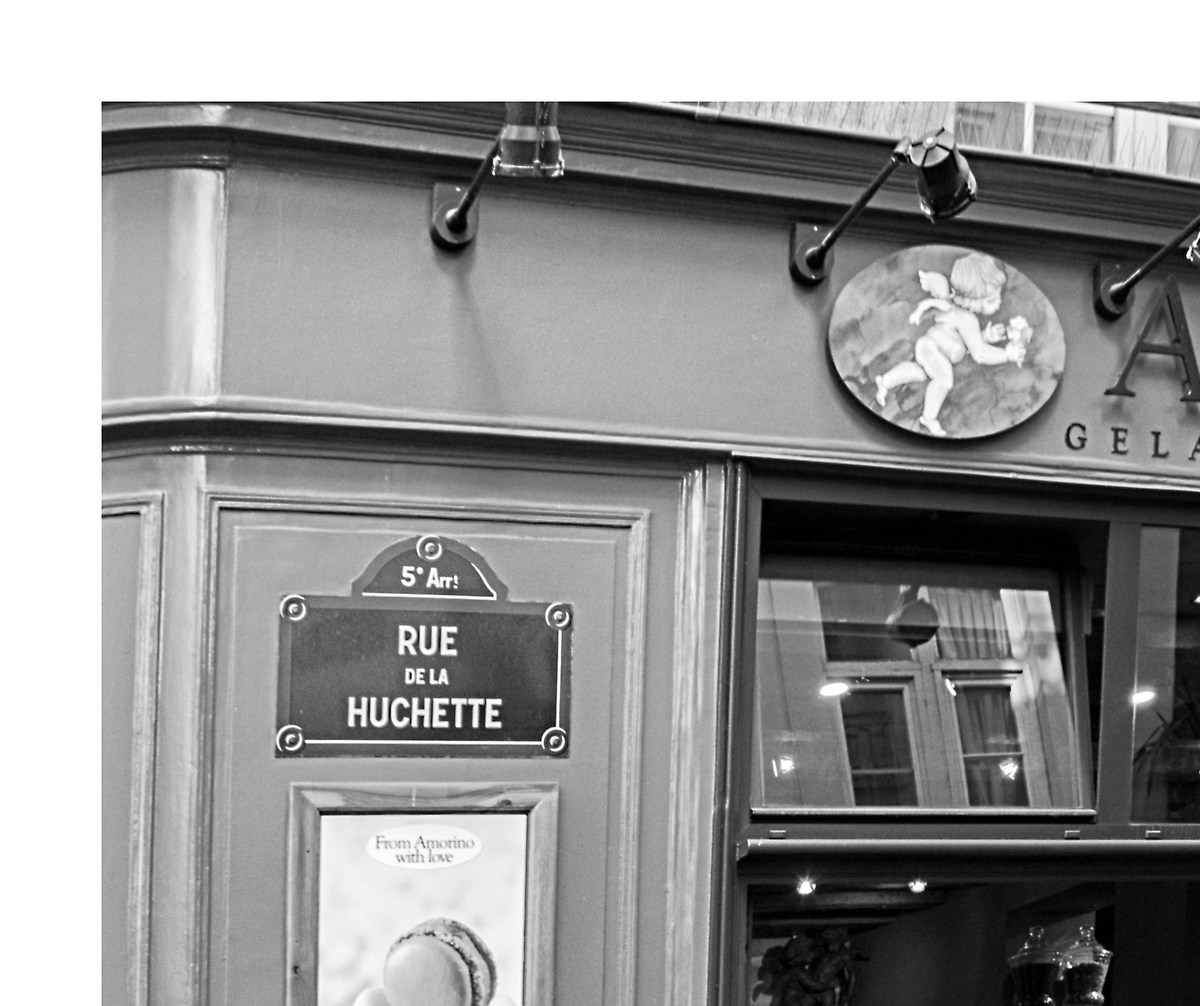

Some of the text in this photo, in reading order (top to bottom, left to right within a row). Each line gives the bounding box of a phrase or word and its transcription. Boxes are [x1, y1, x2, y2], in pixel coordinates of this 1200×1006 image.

[398, 625, 458, 657] RUE
[405, 668, 449, 686] DE LA
[347, 696, 503, 730] HUCHETTE
[376, 834, 475, 849] From Amorino
[395, 848, 454, 863] with love
